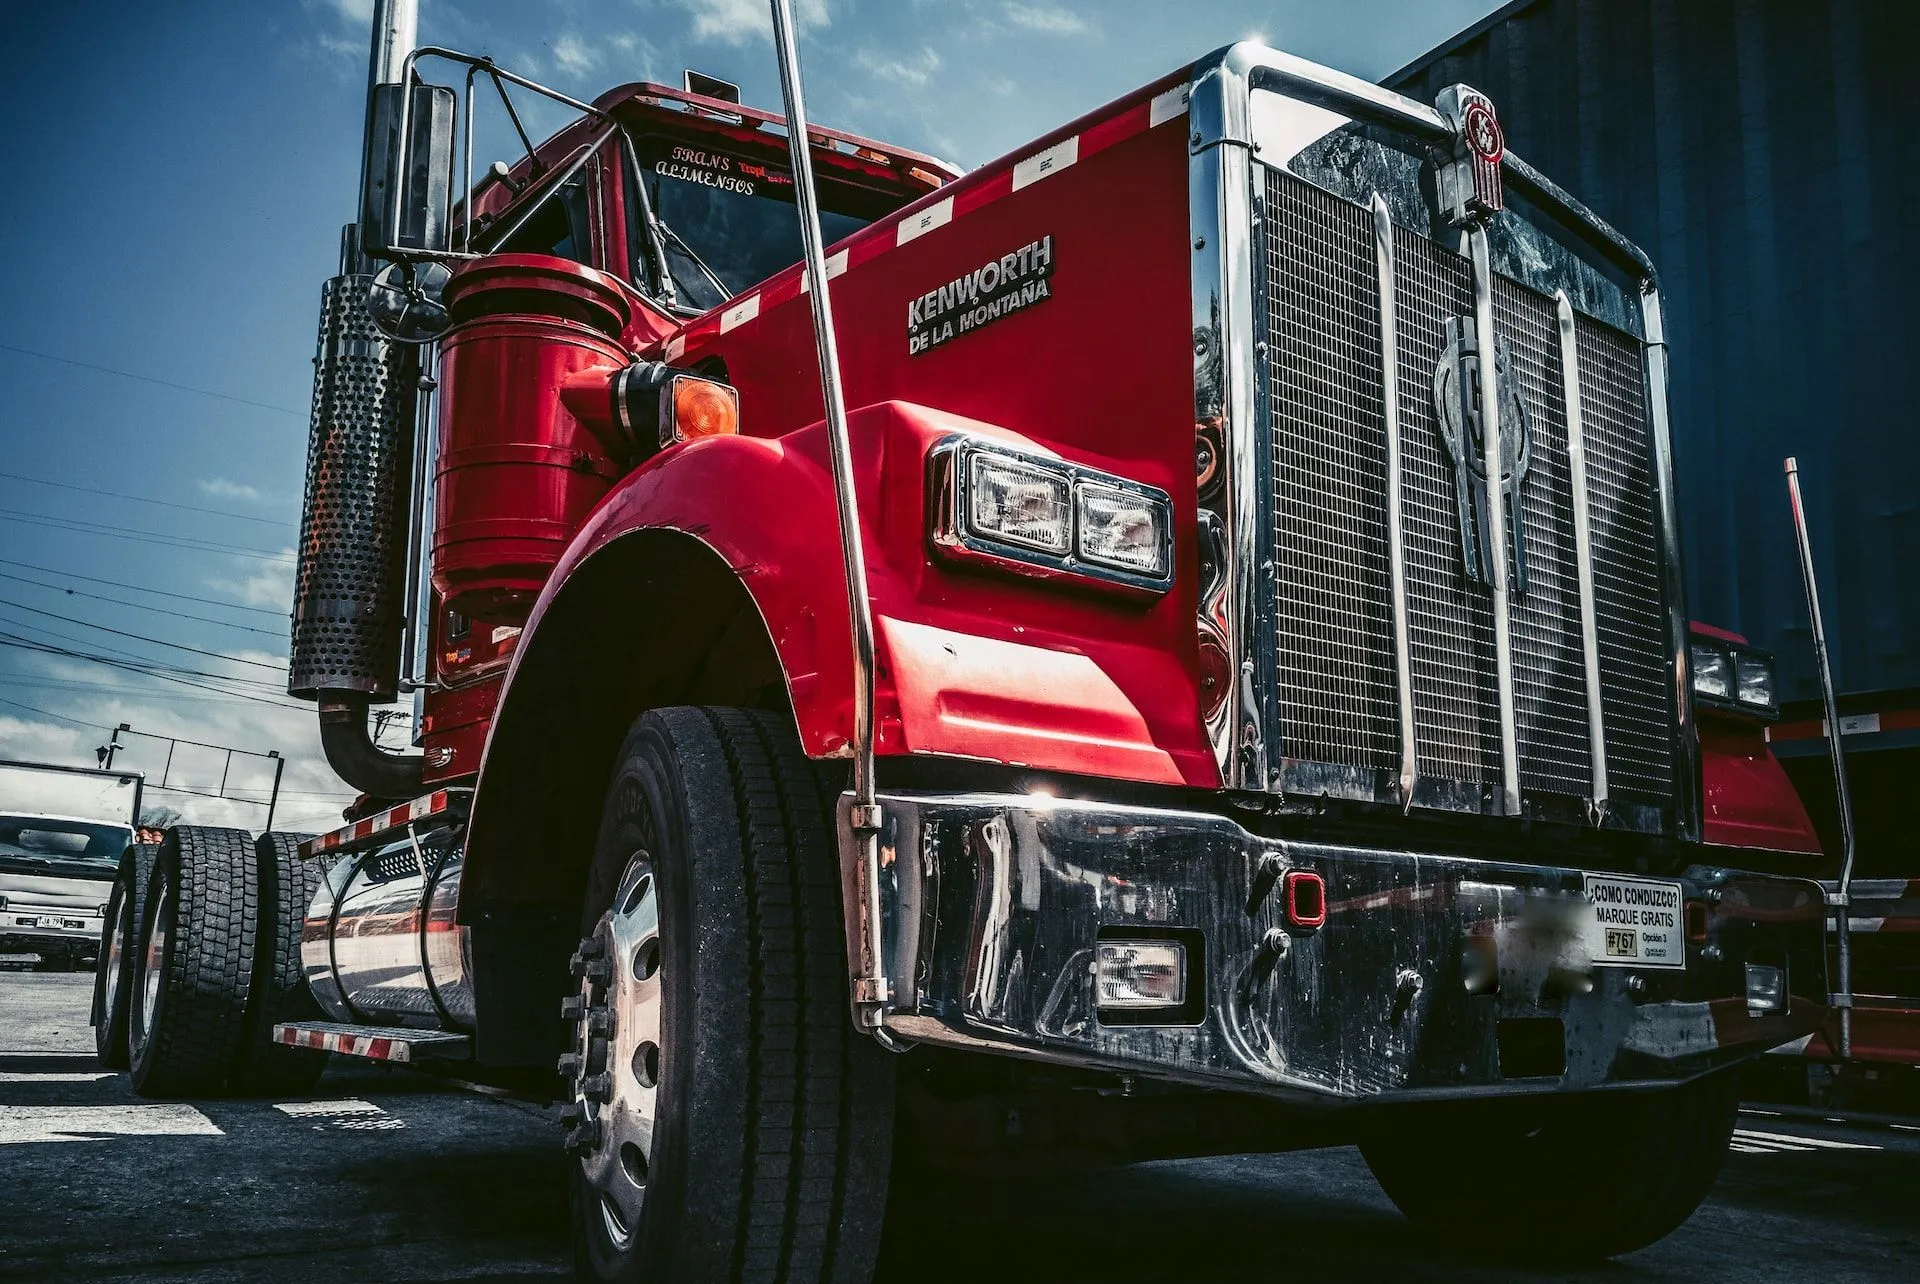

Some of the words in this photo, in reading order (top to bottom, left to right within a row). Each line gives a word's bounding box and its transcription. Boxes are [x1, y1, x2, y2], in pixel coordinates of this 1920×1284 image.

[671, 146, 730, 171] TRANS
[655, 160, 755, 196] ALIMENTOS
[908, 234, 1051, 329] KENWORTH
[909, 330, 929, 355] DE
[932, 320, 954, 345] LA
[959, 278, 1051, 333] MONTAÑA
[1624, 887, 1678, 909] CONDUZCO?
[1596, 907, 1639, 925] MARQUE
[1640, 910, 1674, 928] GRATIS
[1608, 931, 1635, 949] #767
